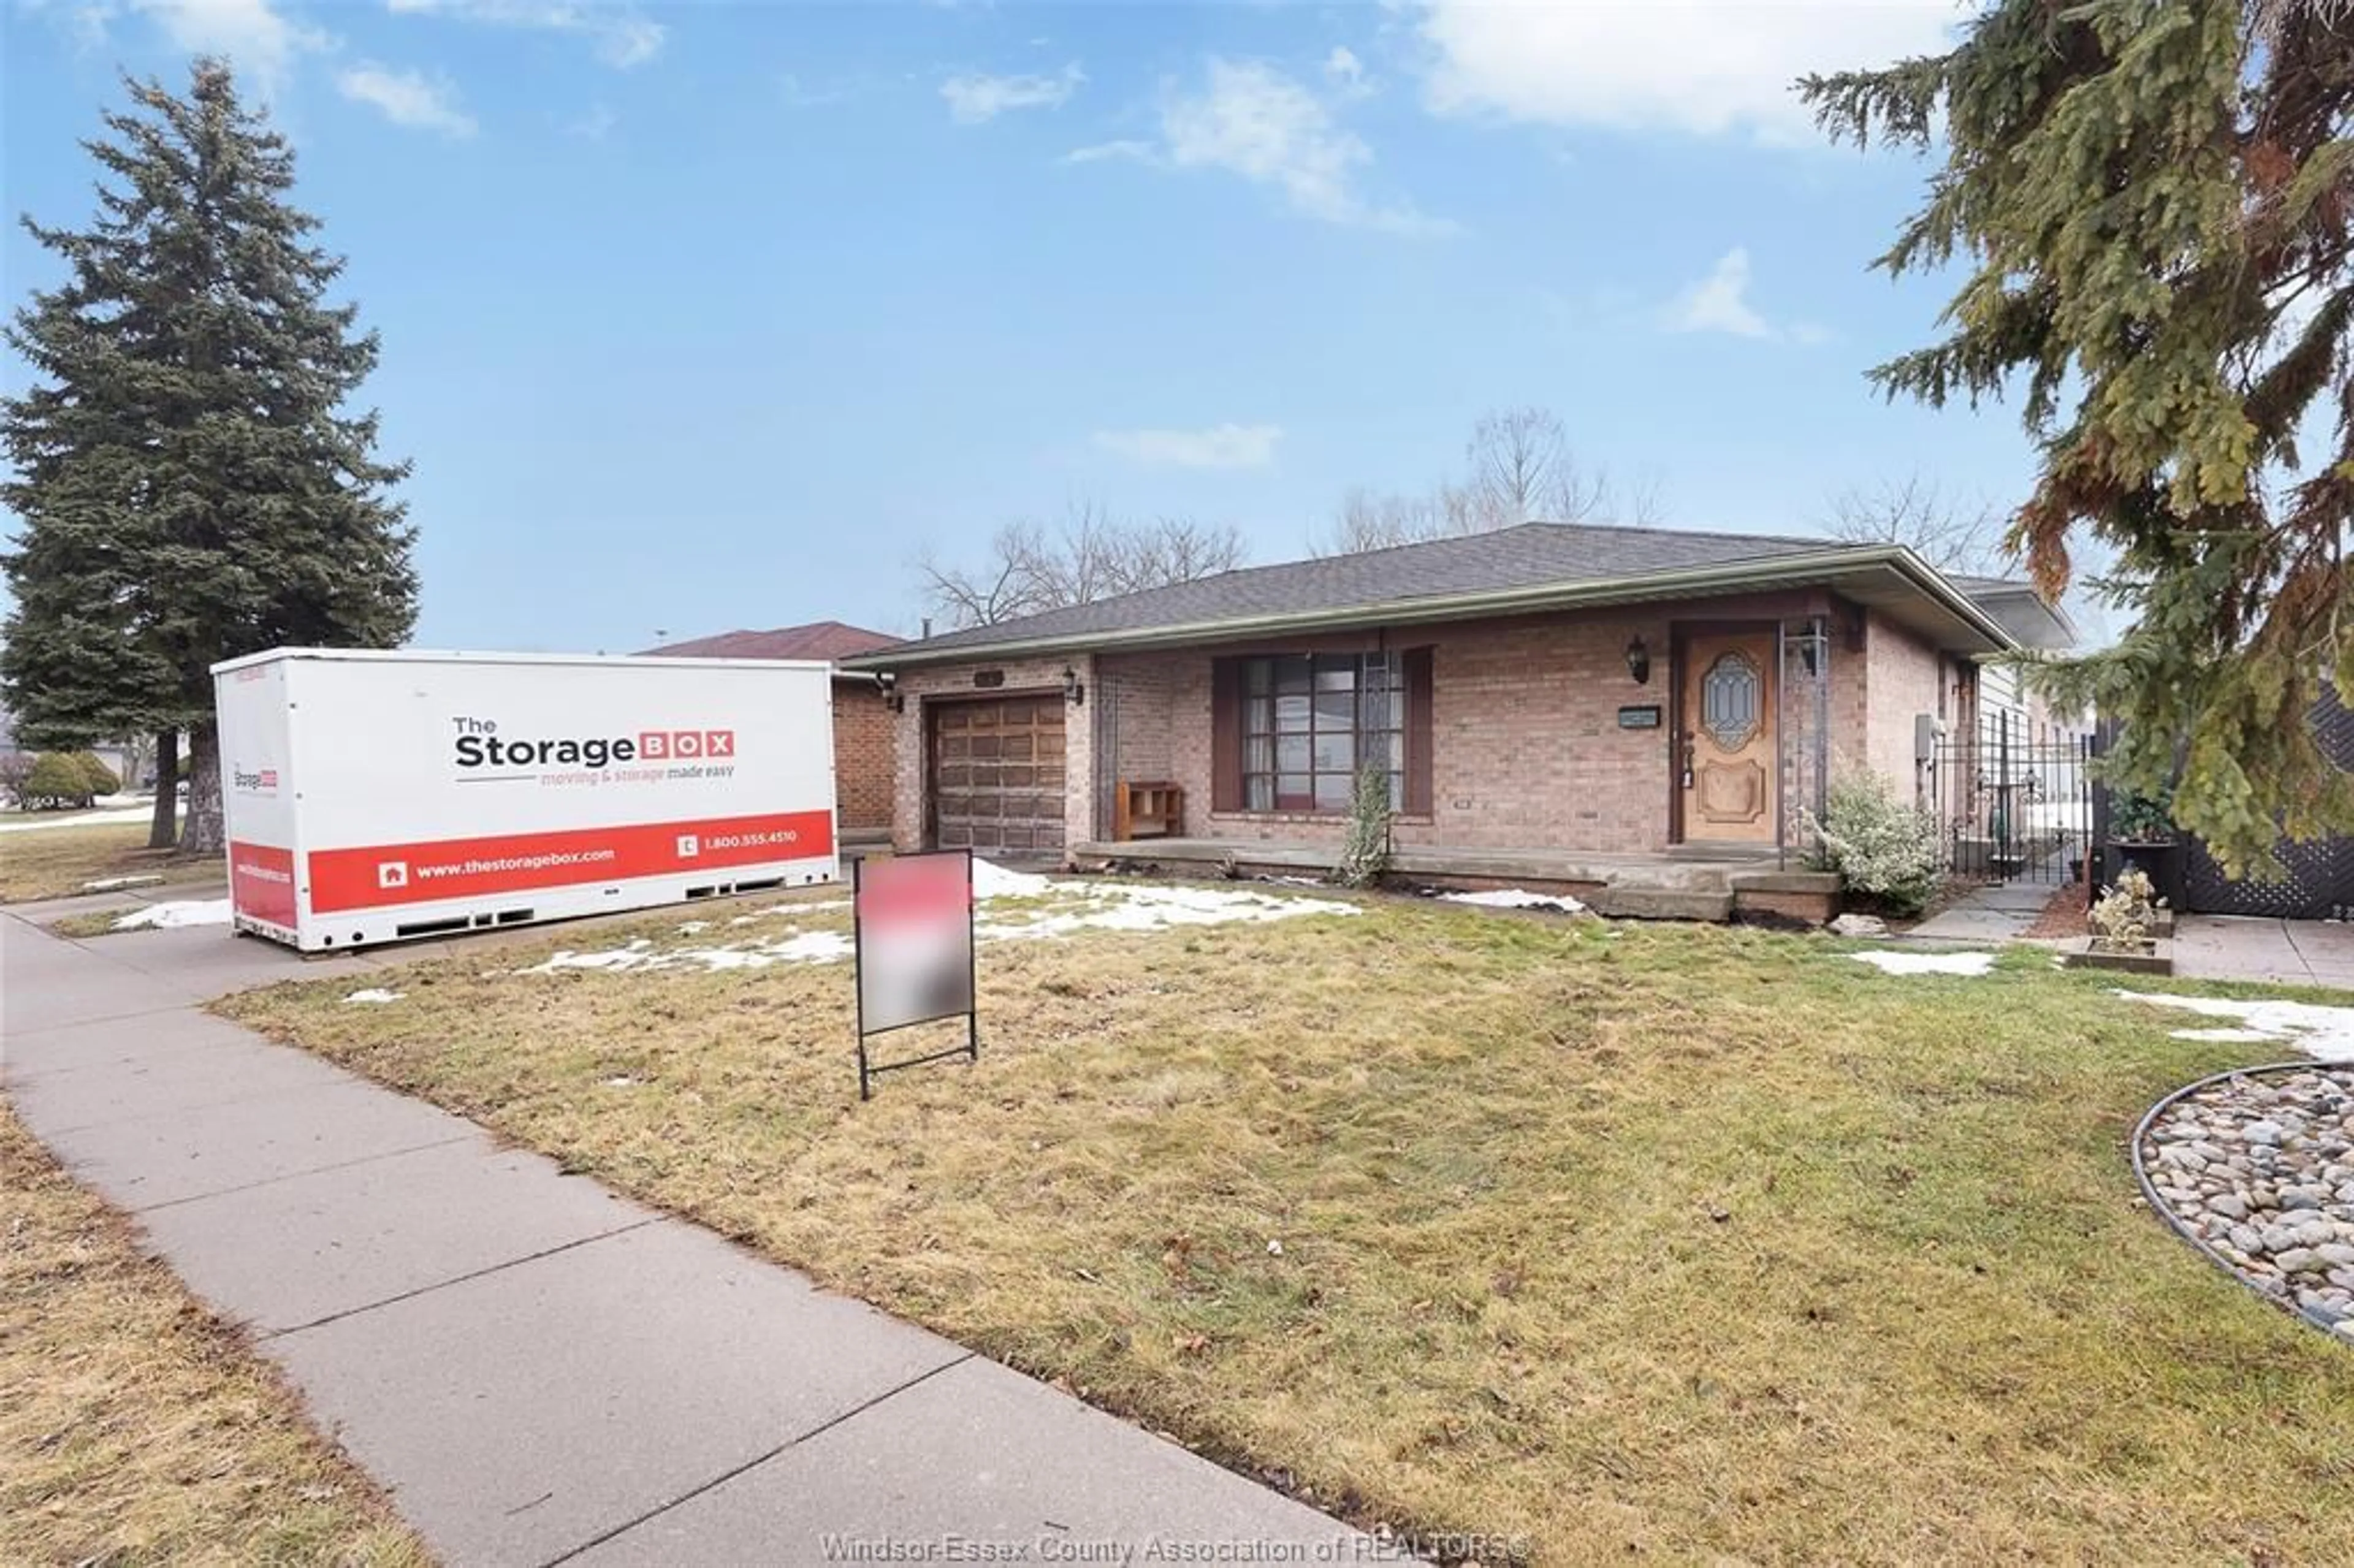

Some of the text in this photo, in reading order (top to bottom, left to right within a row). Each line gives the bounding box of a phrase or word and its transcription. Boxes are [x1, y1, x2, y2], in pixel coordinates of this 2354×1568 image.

[453, 717, 497, 734] The
[455, 736, 635, 768] Storage
[541, 771, 598, 786] moving
[614, 767, 665, 784] storage
[667, 766, 704, 779] made
[416, 849, 615, 880] www.thestoragebox.com
